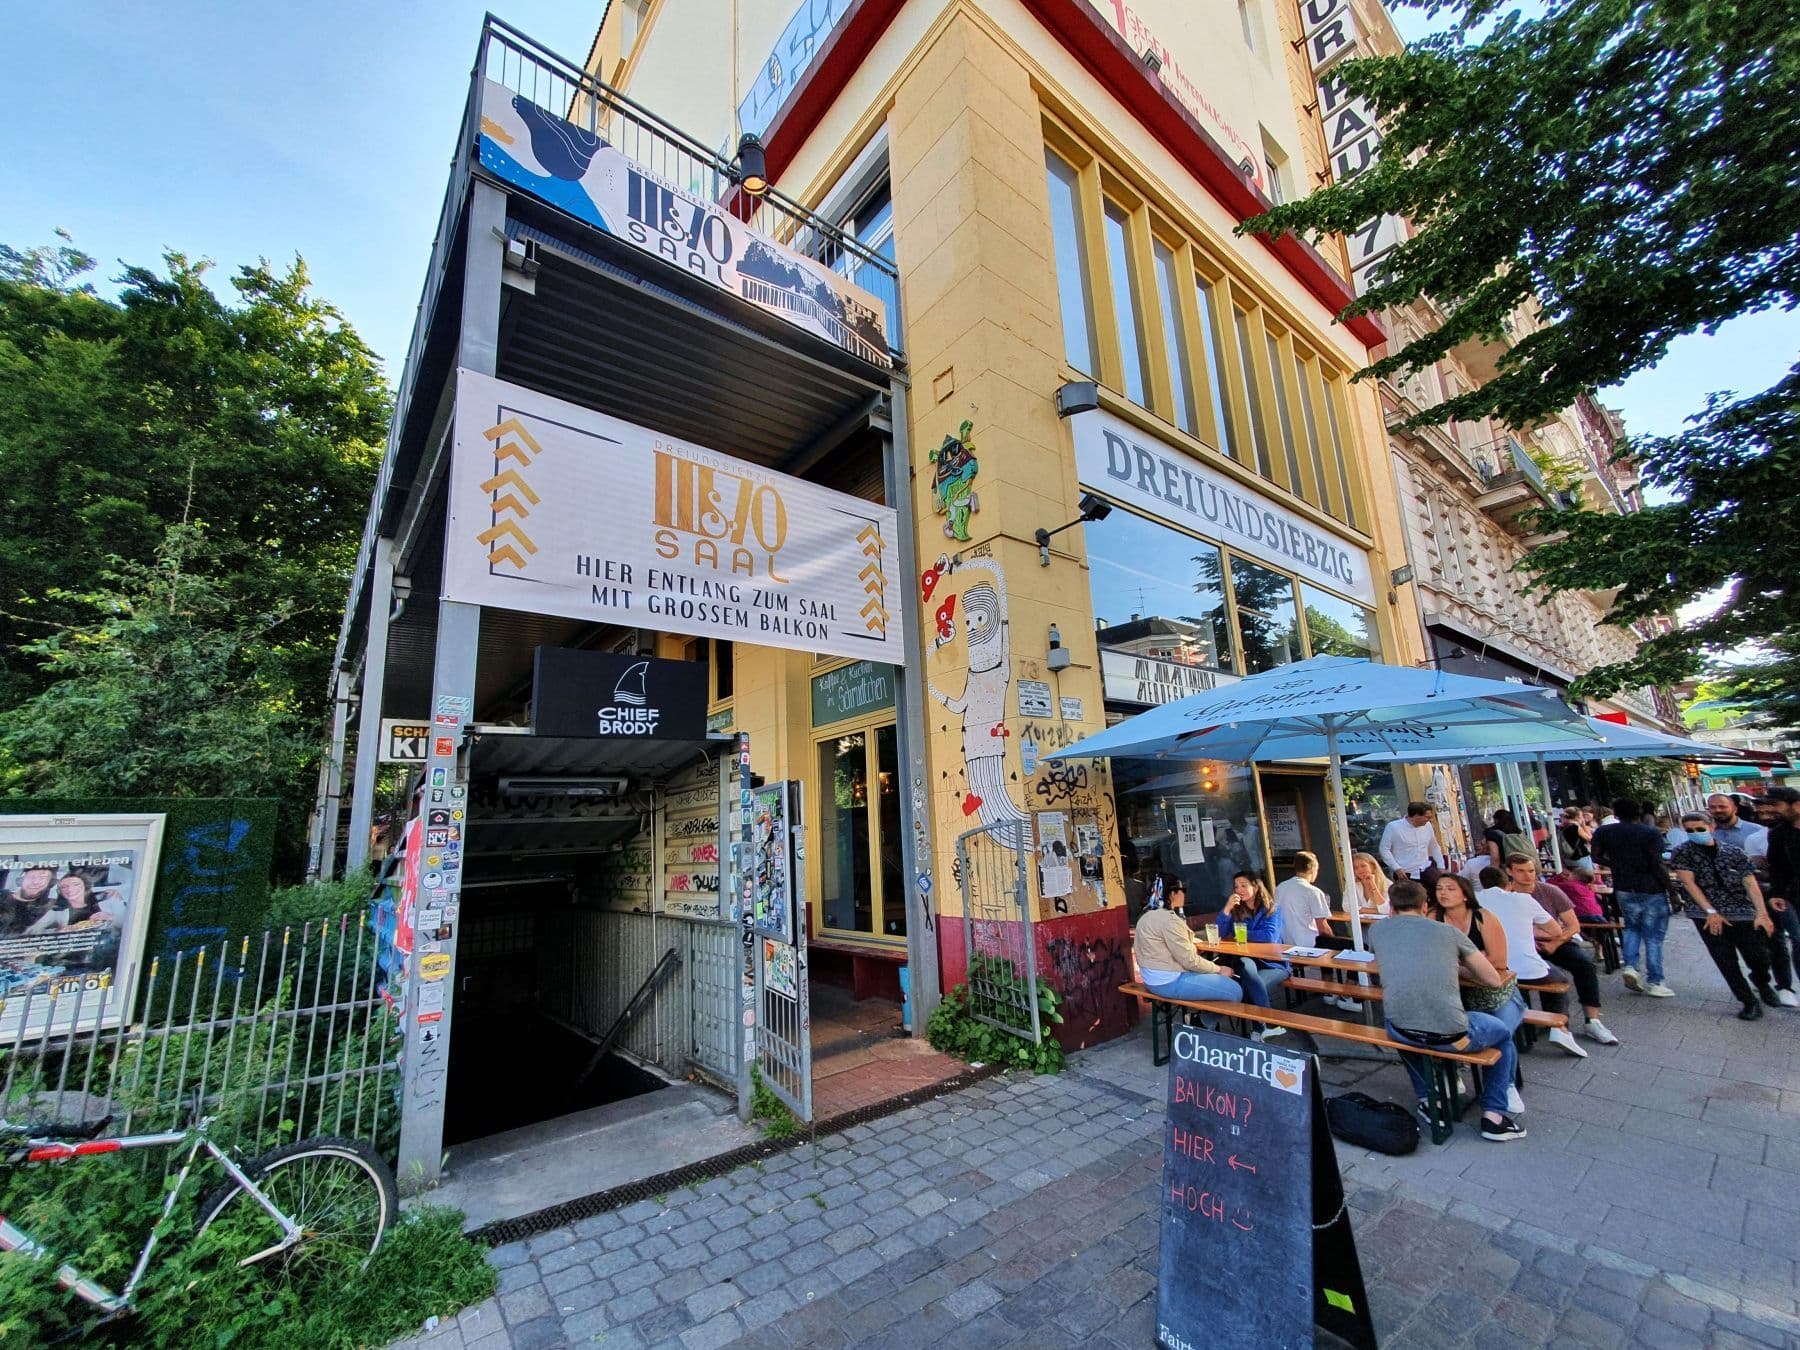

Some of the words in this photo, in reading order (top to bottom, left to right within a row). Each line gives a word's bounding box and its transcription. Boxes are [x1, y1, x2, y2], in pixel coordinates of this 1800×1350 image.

[628, 221, 734, 289] SAAL
[1103, 429, 1354, 586] DREIUNDSIEBZIG
[655, 529, 790, 583] SAAL
[576, 555, 633, 585] HIER
[648, 568, 740, 603] ENTLANG
[752, 588, 789, 612] ZUM
[799, 598, 838, 622] SAAL
[592, 584, 633, 609] MIT
[648, 594, 749, 628] GROSSEM
[760, 613, 829, 641] BALKON
[598, 707, 660, 721] CHIEF
[600, 720, 659, 735] BRODY
[38, 859, 69, 868] neu
[72, 855, 130, 866] erleben
[1173, 1127, 1217, 1165] HIER
[1170, 1180, 1225, 1223] HOCH
